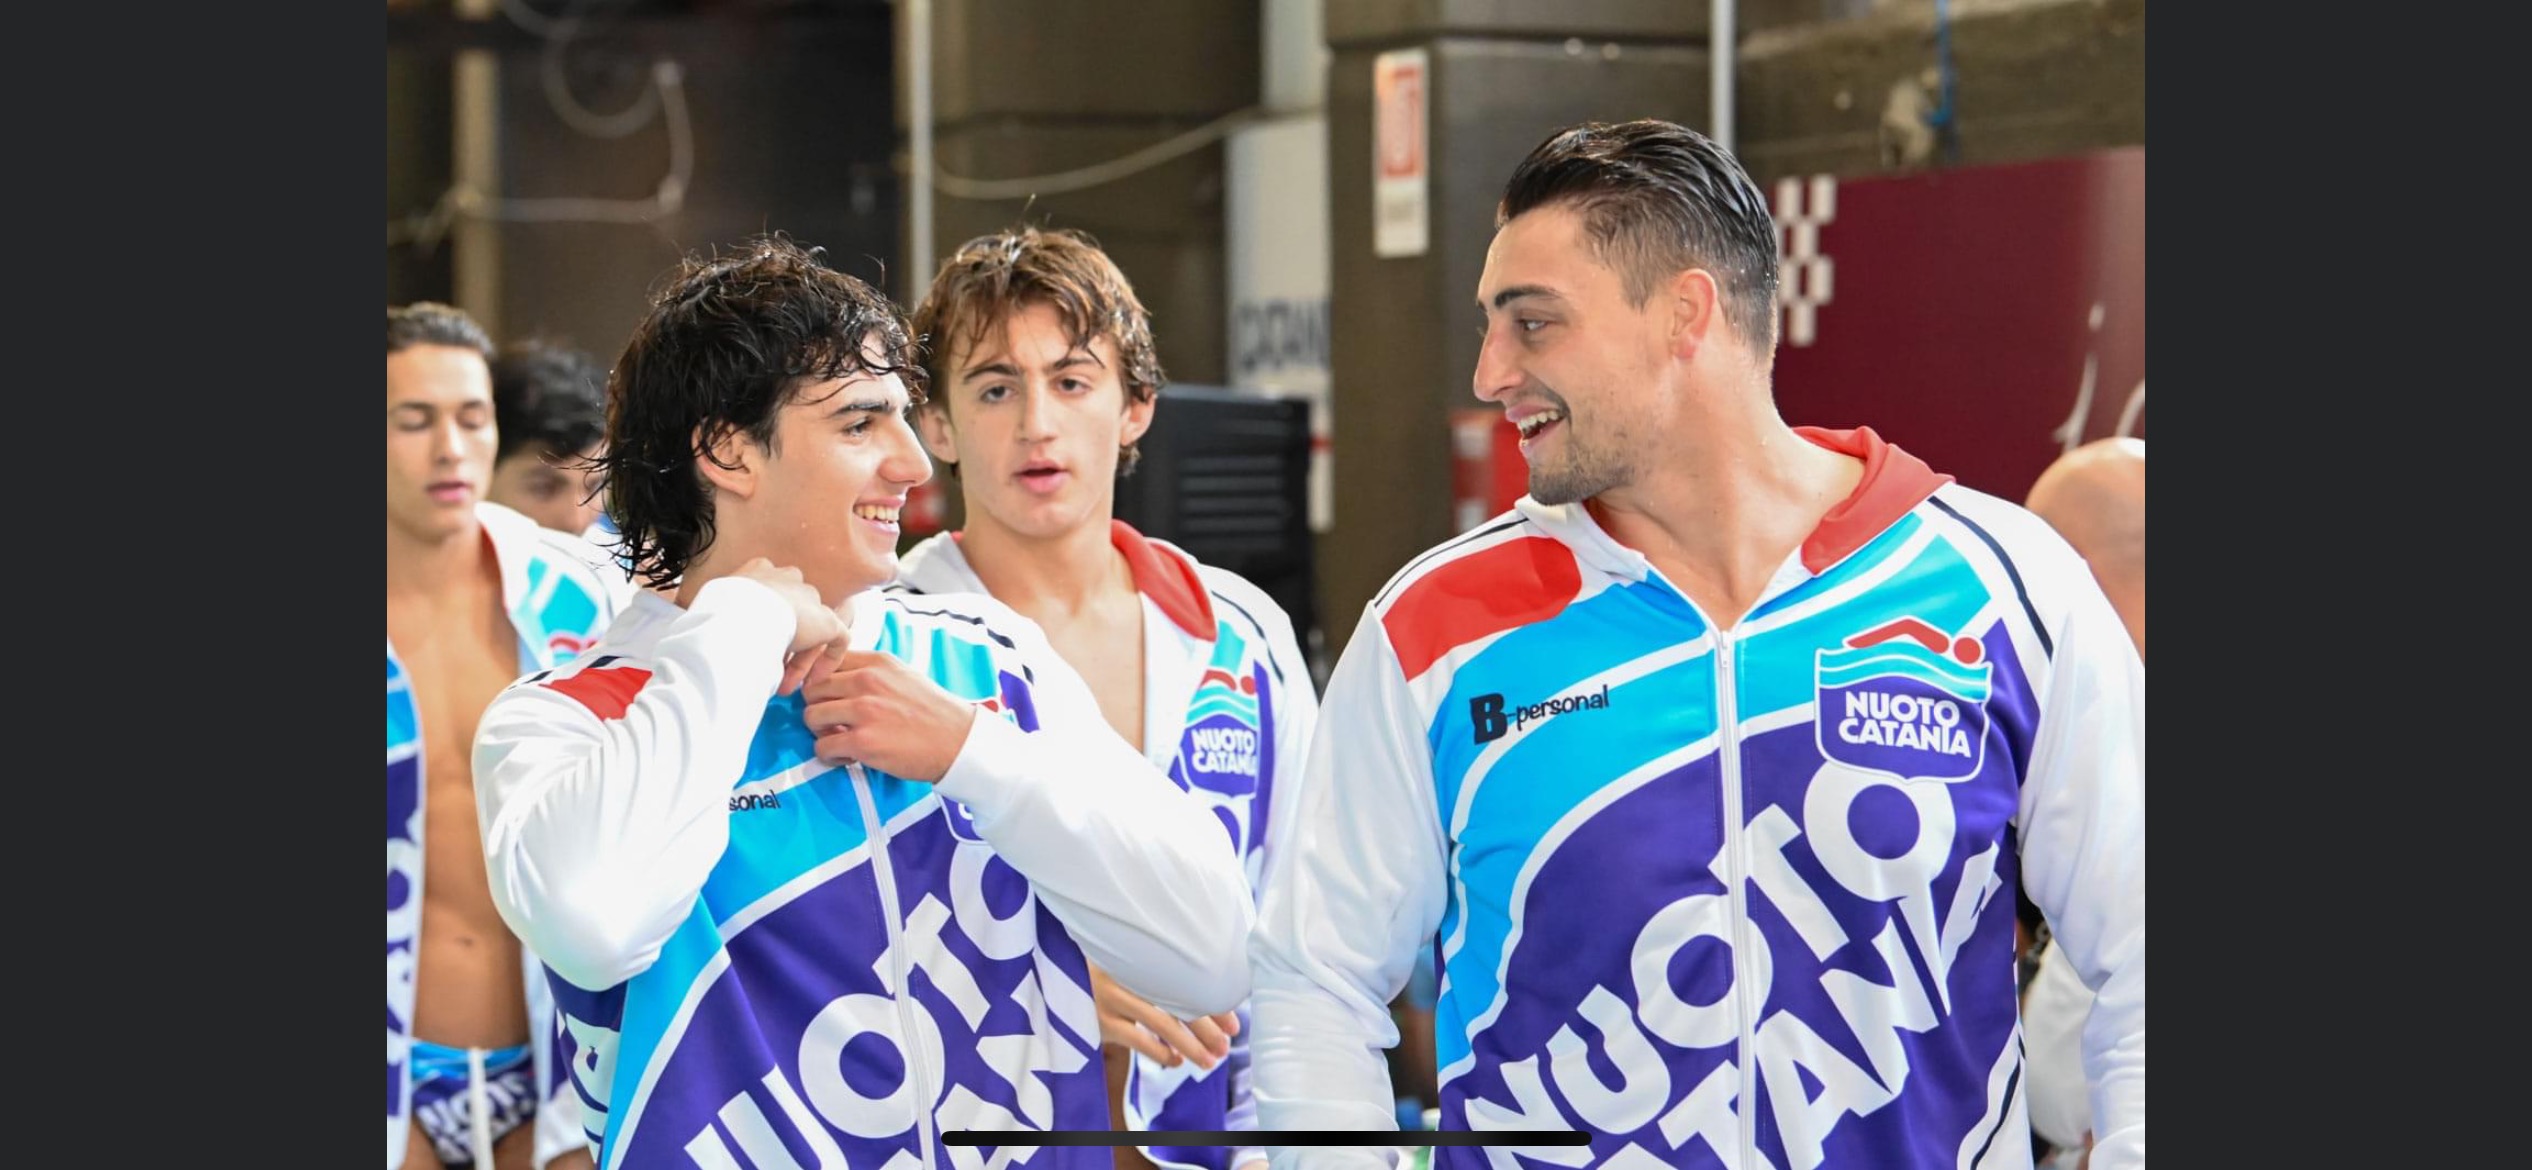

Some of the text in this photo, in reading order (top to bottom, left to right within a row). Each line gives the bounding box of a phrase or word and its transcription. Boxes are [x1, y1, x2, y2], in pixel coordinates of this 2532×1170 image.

[1845, 690, 1961, 729] NUOTO
[1190, 727, 1256, 756] NUOTO
[1838, 717, 1972, 758] CATANIA
[1465, 758, 1956, 1170] NUOTO
